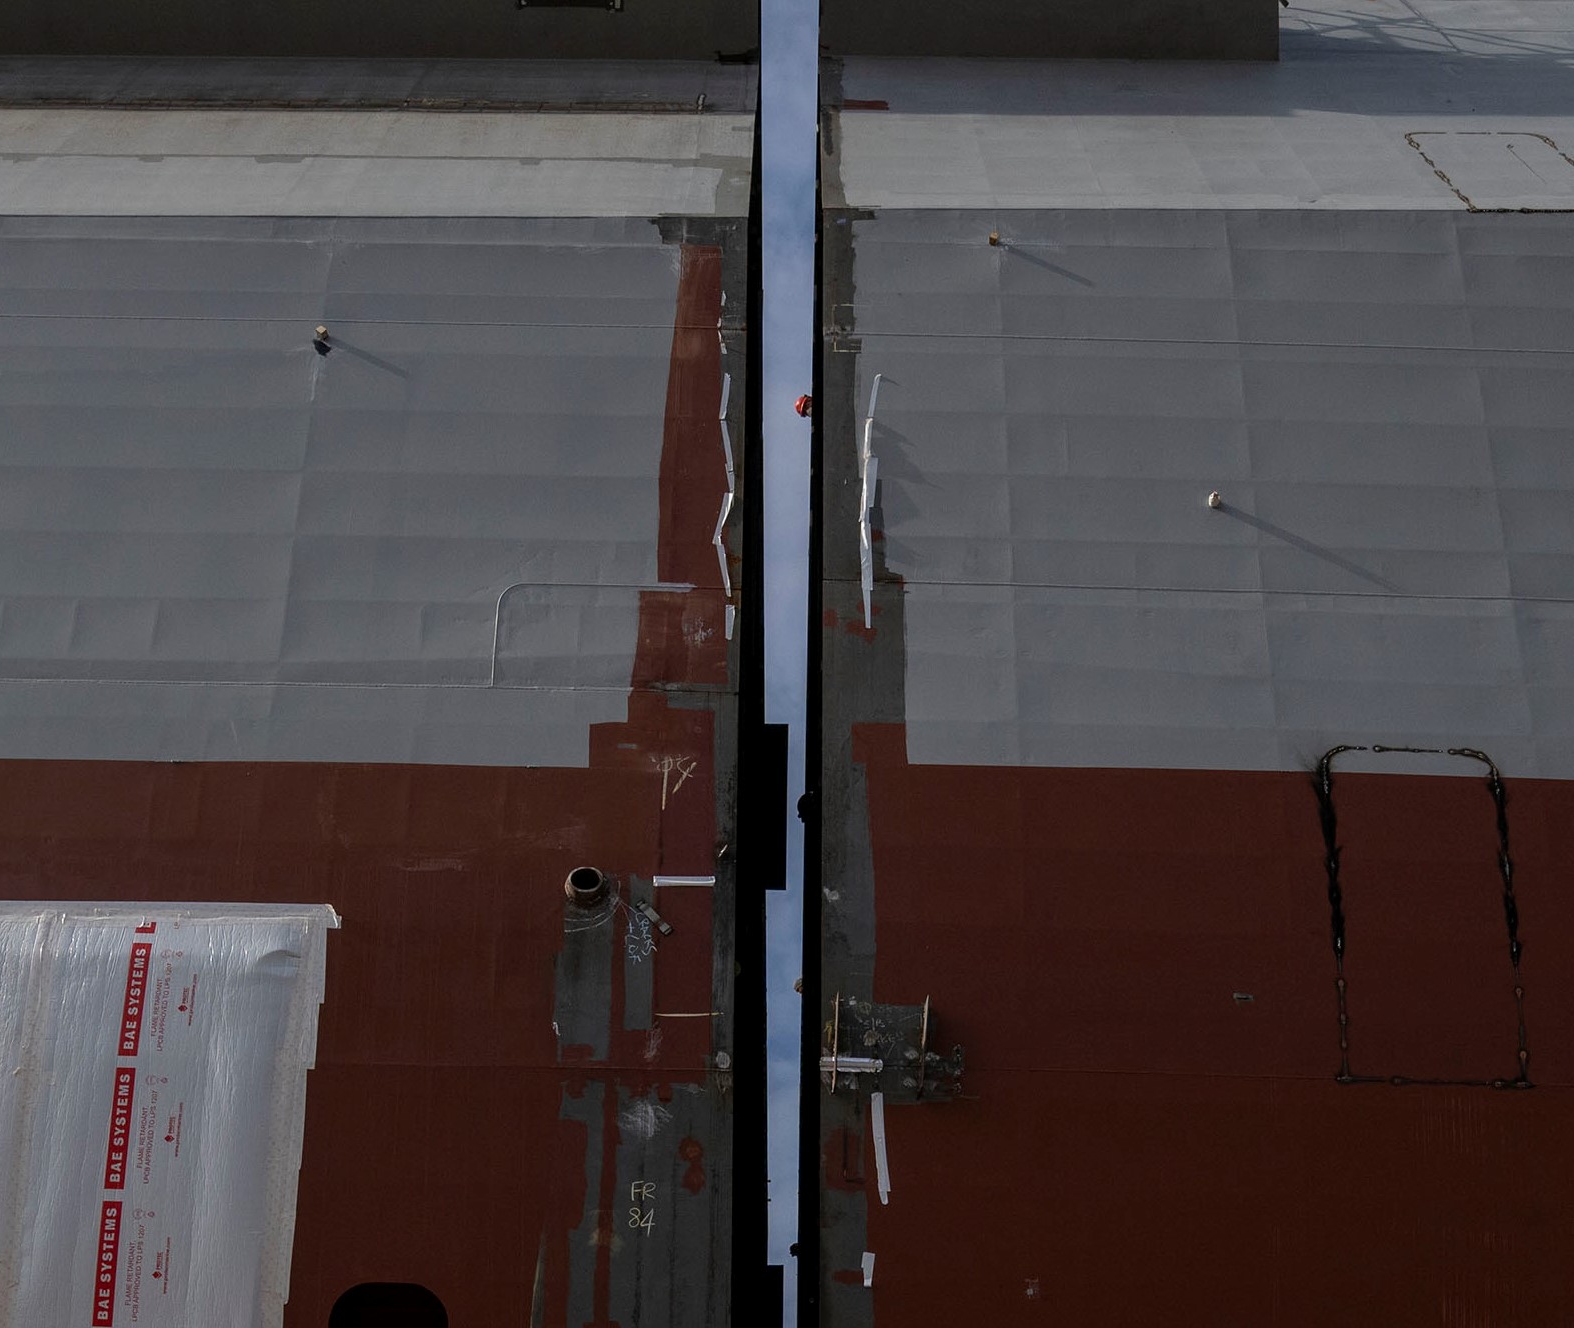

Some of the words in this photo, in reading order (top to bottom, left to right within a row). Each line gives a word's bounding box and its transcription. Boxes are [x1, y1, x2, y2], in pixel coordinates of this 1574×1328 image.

[127, 947, 147, 1017] SYSTEMS
[122, 1020, 138, 1051] BAE
[112, 1073, 132, 1147] SYSTEMS
[109, 1151, 124, 1183] BAE
[630, 1180, 657, 1202] FR
[628, 1207, 656, 1238] 84
[99, 1206, 118, 1284] SYSTEMS
[97, 1287, 111, 1321] BAE
